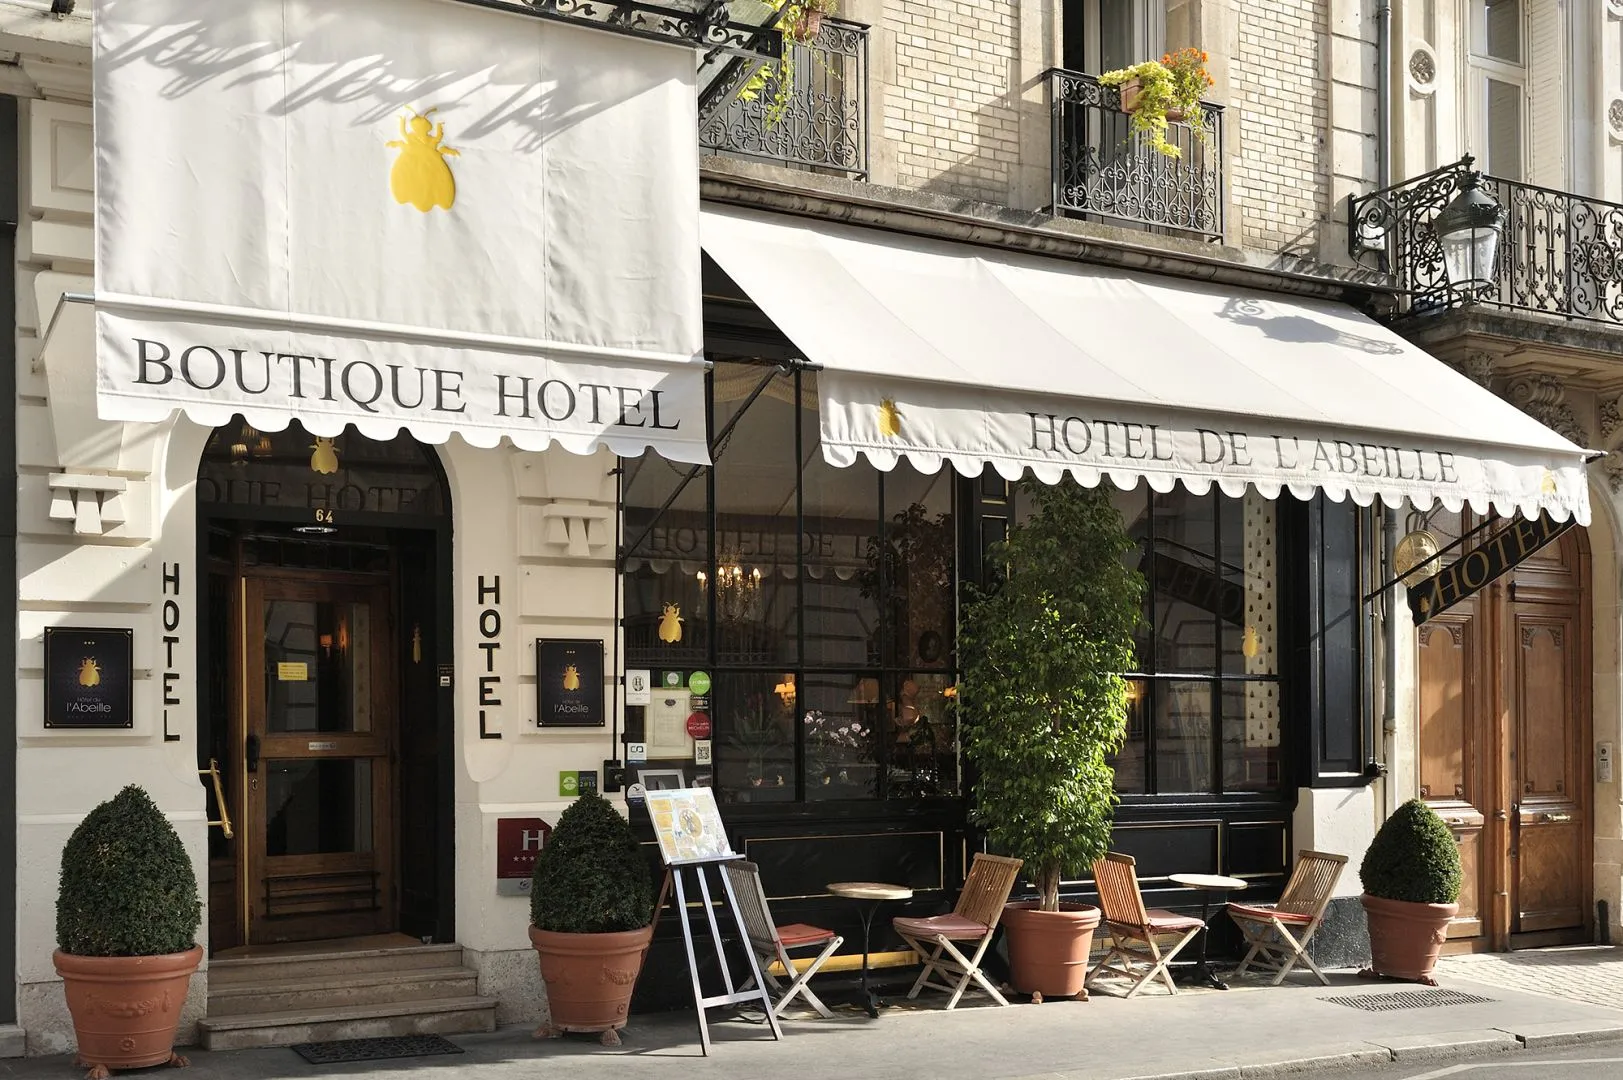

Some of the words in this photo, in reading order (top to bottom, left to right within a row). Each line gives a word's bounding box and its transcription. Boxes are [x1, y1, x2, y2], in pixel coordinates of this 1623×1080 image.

[132, 338, 467, 413] BOUTIQUE
[493, 374, 682, 431] HOTEL
[1028, 412, 1174, 461] HOTEL
[1196, 428, 1253, 467] DE
[1271, 433, 1460, 485] L'ABEILLE
[315, 509, 334, 523] 64
[1431, 509, 1565, 609] HOTEL
[162, 562, 181, 742] HOTEL
[477, 575, 502, 740] HOTEL
[66, 702, 112, 713] l'Abeille
[554, 704, 589, 713] l'Abeille
[521, 829, 545, 851] H
